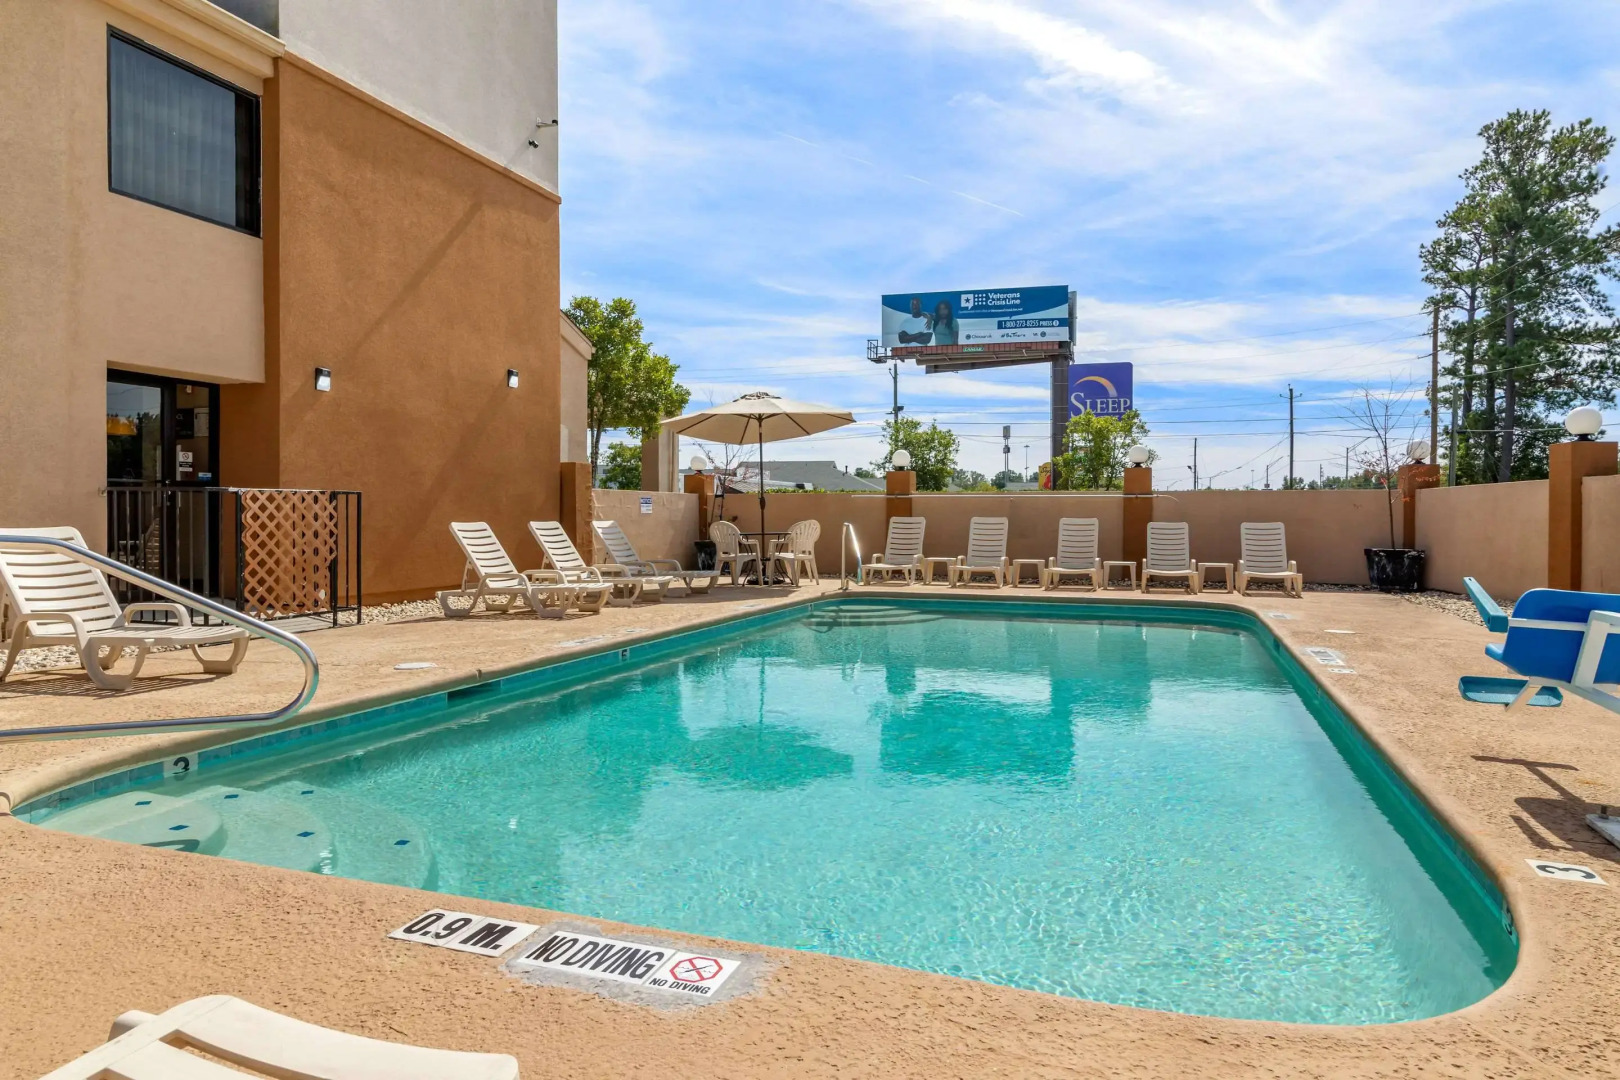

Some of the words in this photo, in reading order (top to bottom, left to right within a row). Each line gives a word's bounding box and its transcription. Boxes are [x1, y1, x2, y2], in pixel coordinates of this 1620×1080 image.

[987, 298, 1006, 306] Crisis
[1006, 297, 1021, 305] Line
[1002, 319, 1039, 329] 1-800-273-8255
[1039, 319, 1053, 327] PRESS
[1070, 392, 1131, 418] SLEEP
[1535, 864, 1597, 880] 3
[402, 912, 473, 939] 0.9
[458, 922, 518, 950] M.
[524, 935, 580, 962] NO
[560, 940, 665, 979] DIVING
[648, 977, 666, 987] NO
[668, 981, 711, 995] DIVING
